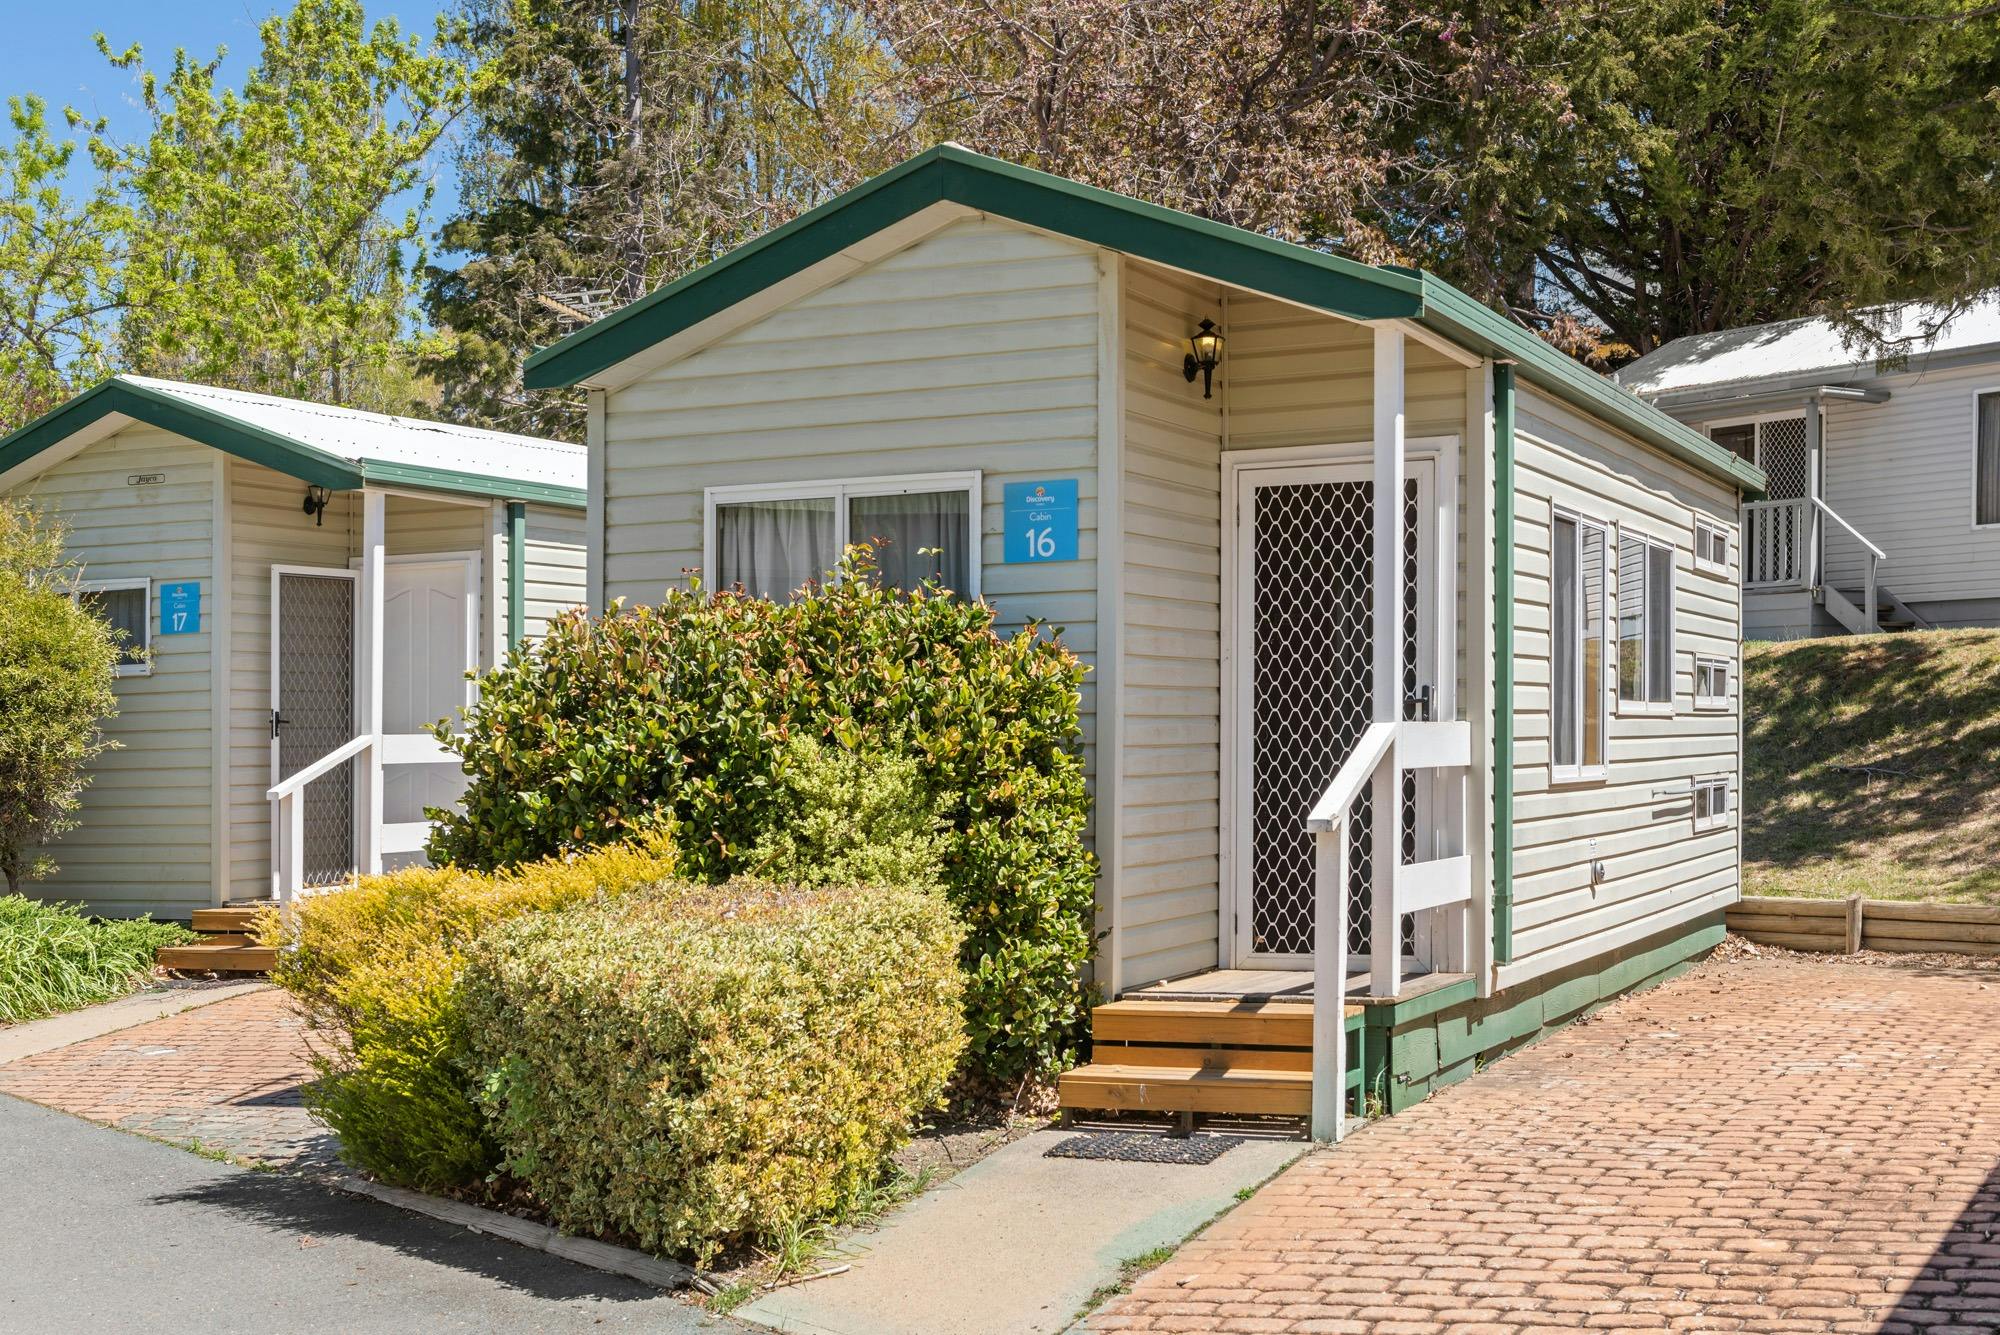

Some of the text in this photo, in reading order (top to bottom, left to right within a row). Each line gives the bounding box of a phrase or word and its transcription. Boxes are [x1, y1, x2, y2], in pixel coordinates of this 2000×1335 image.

[1026, 495, 1055, 503] Discovery
[1029, 512, 1052, 521] Cabin
[1025, 527, 1056, 558] 16
[172, 612, 187, 631] 17
